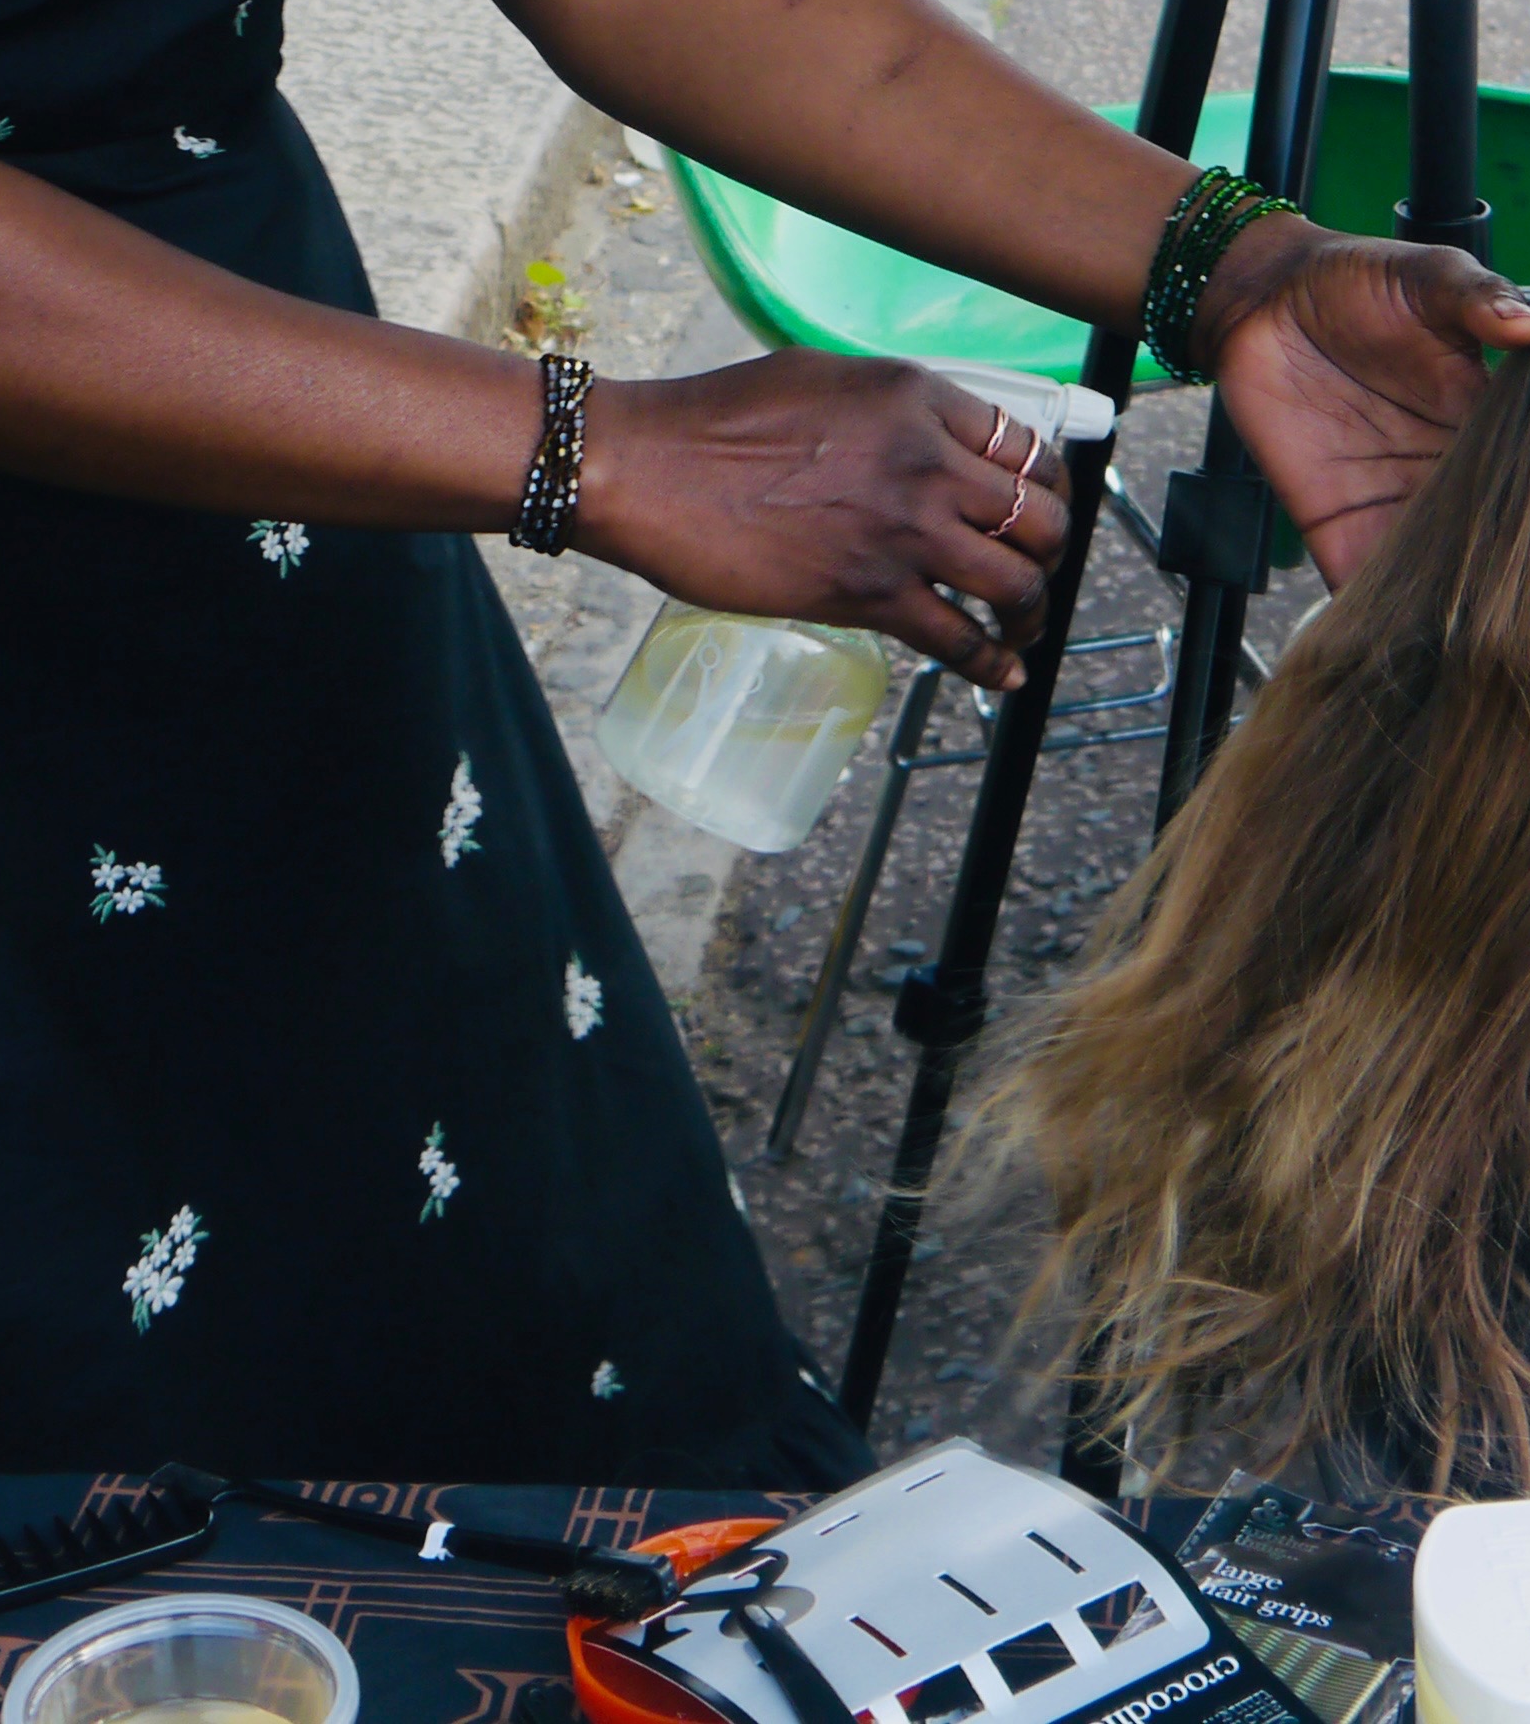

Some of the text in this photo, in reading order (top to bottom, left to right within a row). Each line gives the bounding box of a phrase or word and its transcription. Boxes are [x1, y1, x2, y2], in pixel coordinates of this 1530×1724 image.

[1211, 1557, 1283, 1591] large
[1199, 1577, 1333, 1628] hair grips
[1087, 1656, 1240, 1724] crocodi
